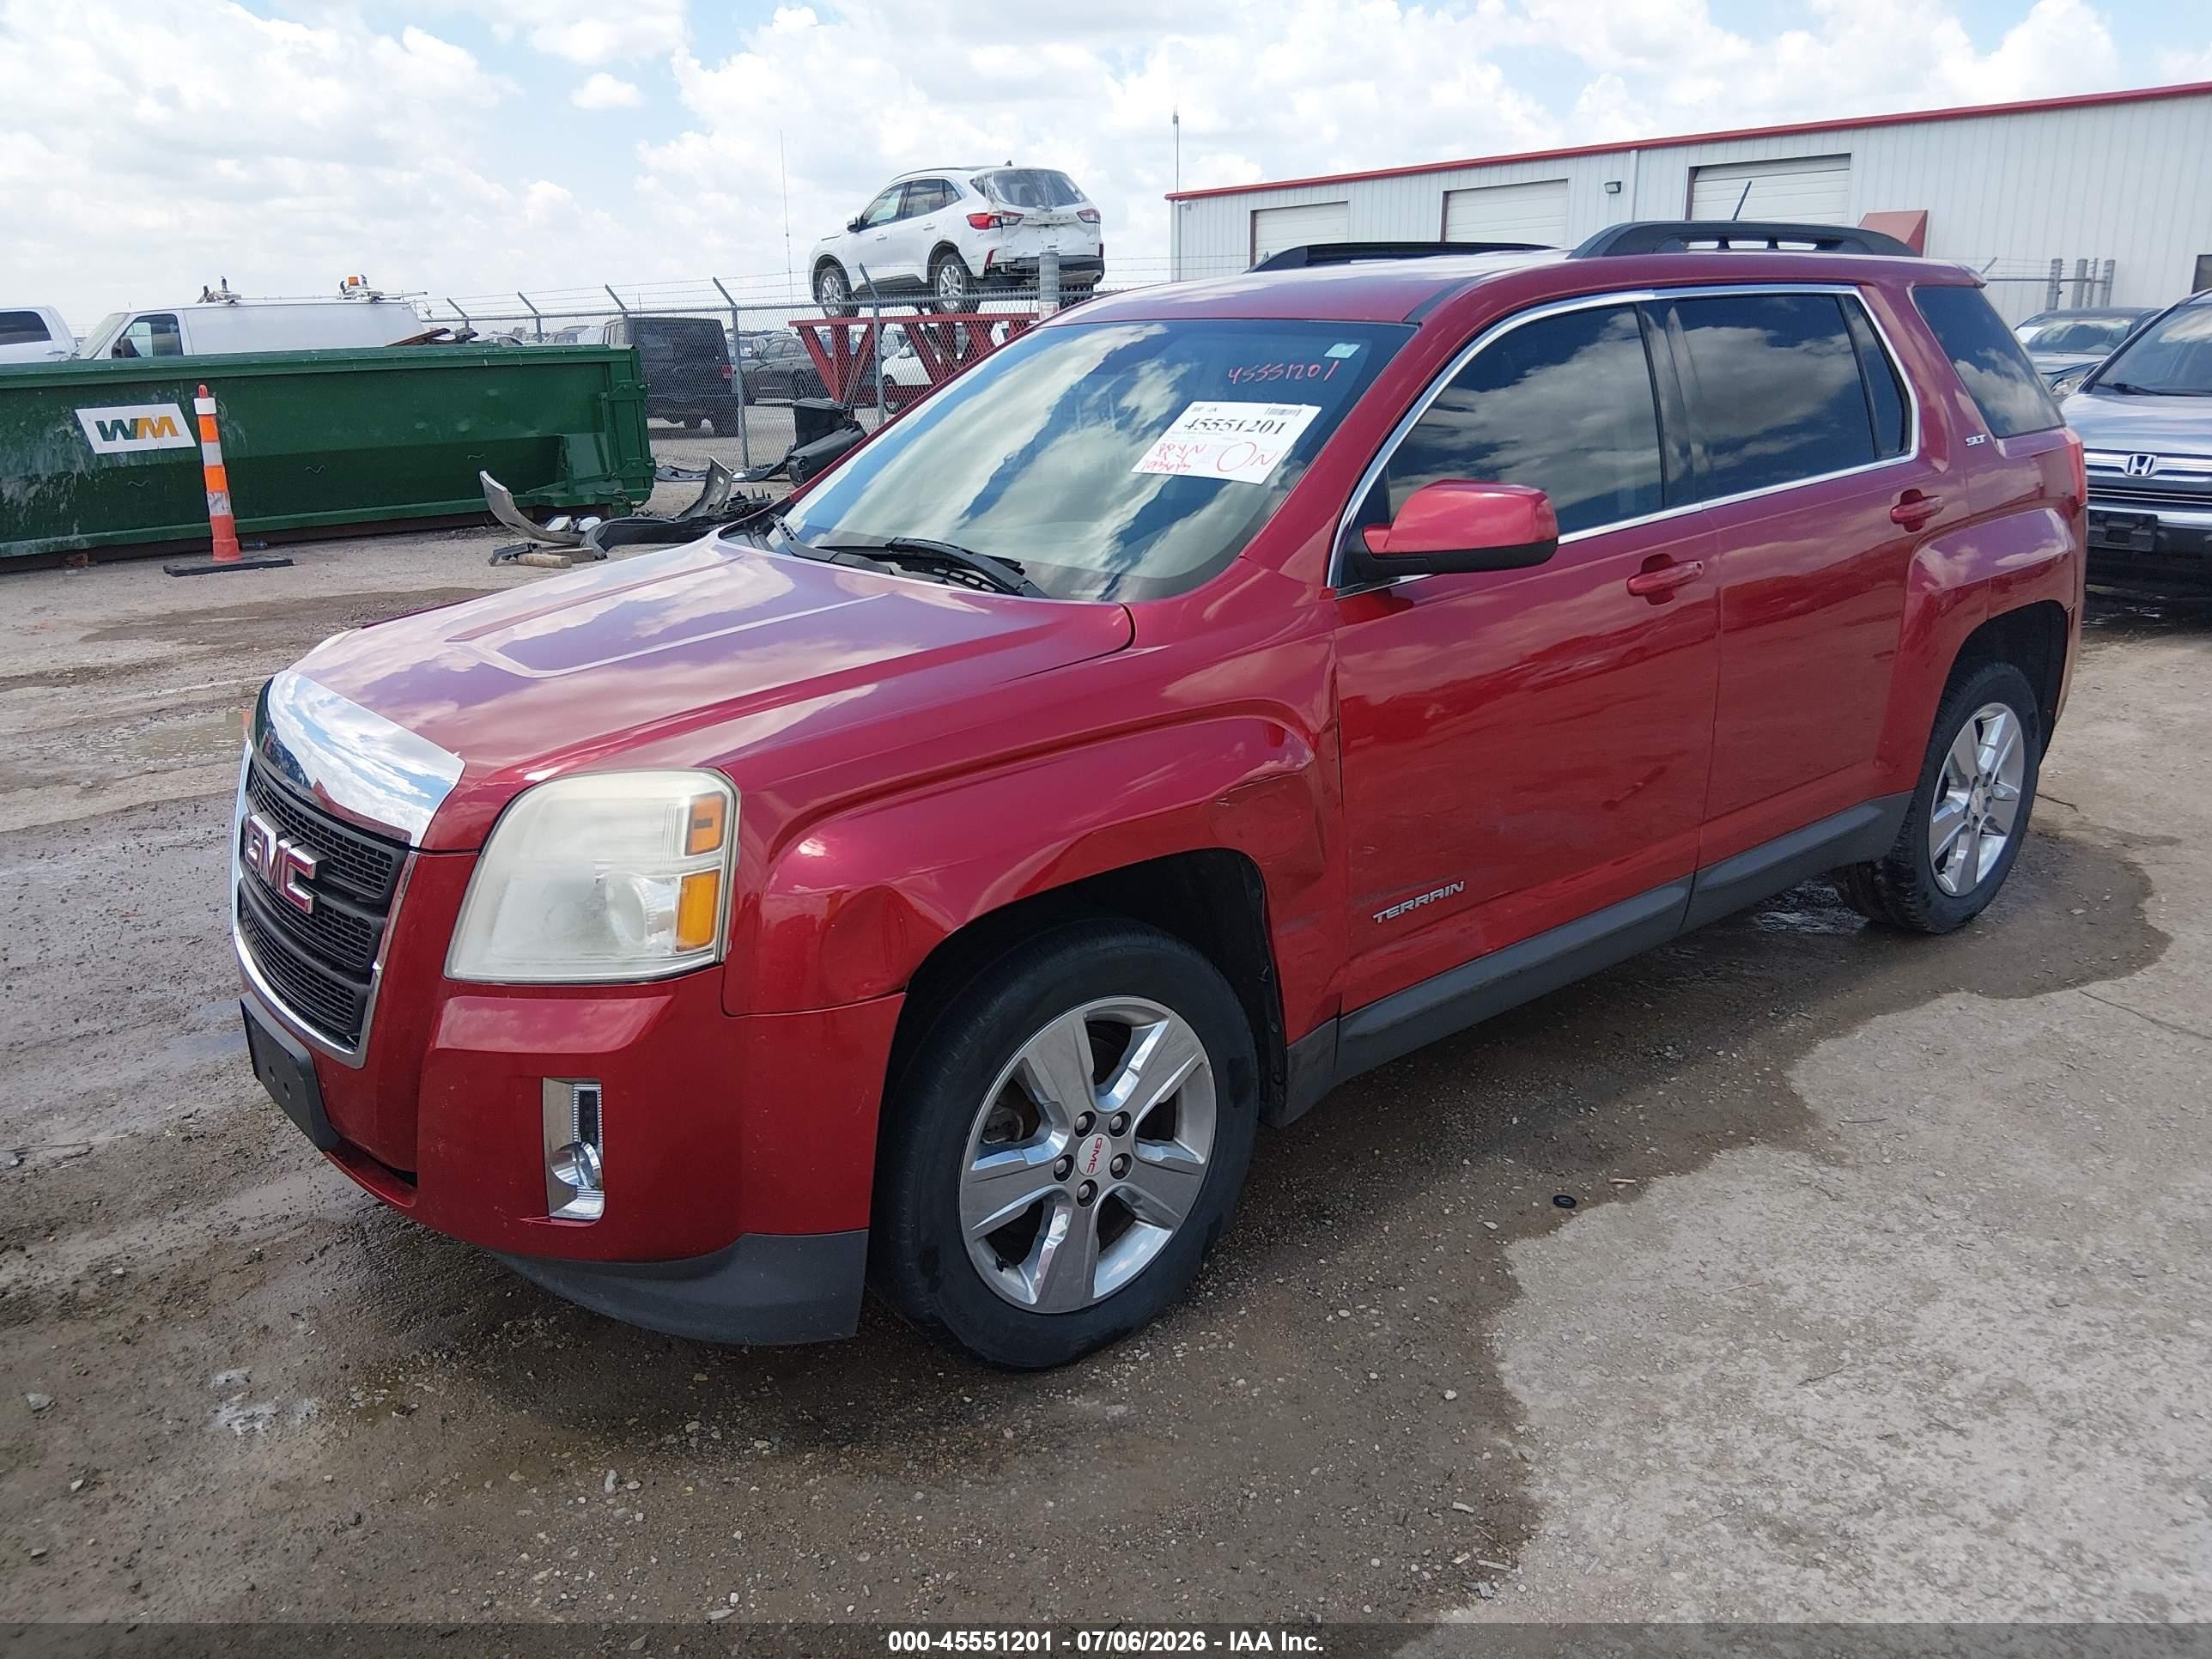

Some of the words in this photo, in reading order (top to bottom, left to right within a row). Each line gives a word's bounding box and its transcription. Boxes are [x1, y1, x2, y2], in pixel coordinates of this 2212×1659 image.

[1228, 360, 1340, 385] 45551201
[95, 416, 179, 441] WM
[1183, 417, 1287, 434] 45551201
[1966, 434, 1985, 446] SLT
[246, 815, 316, 914] GMC
[1372, 881, 1464, 923] TERRAIN
[1086, 1137, 1103, 1174] GMC
